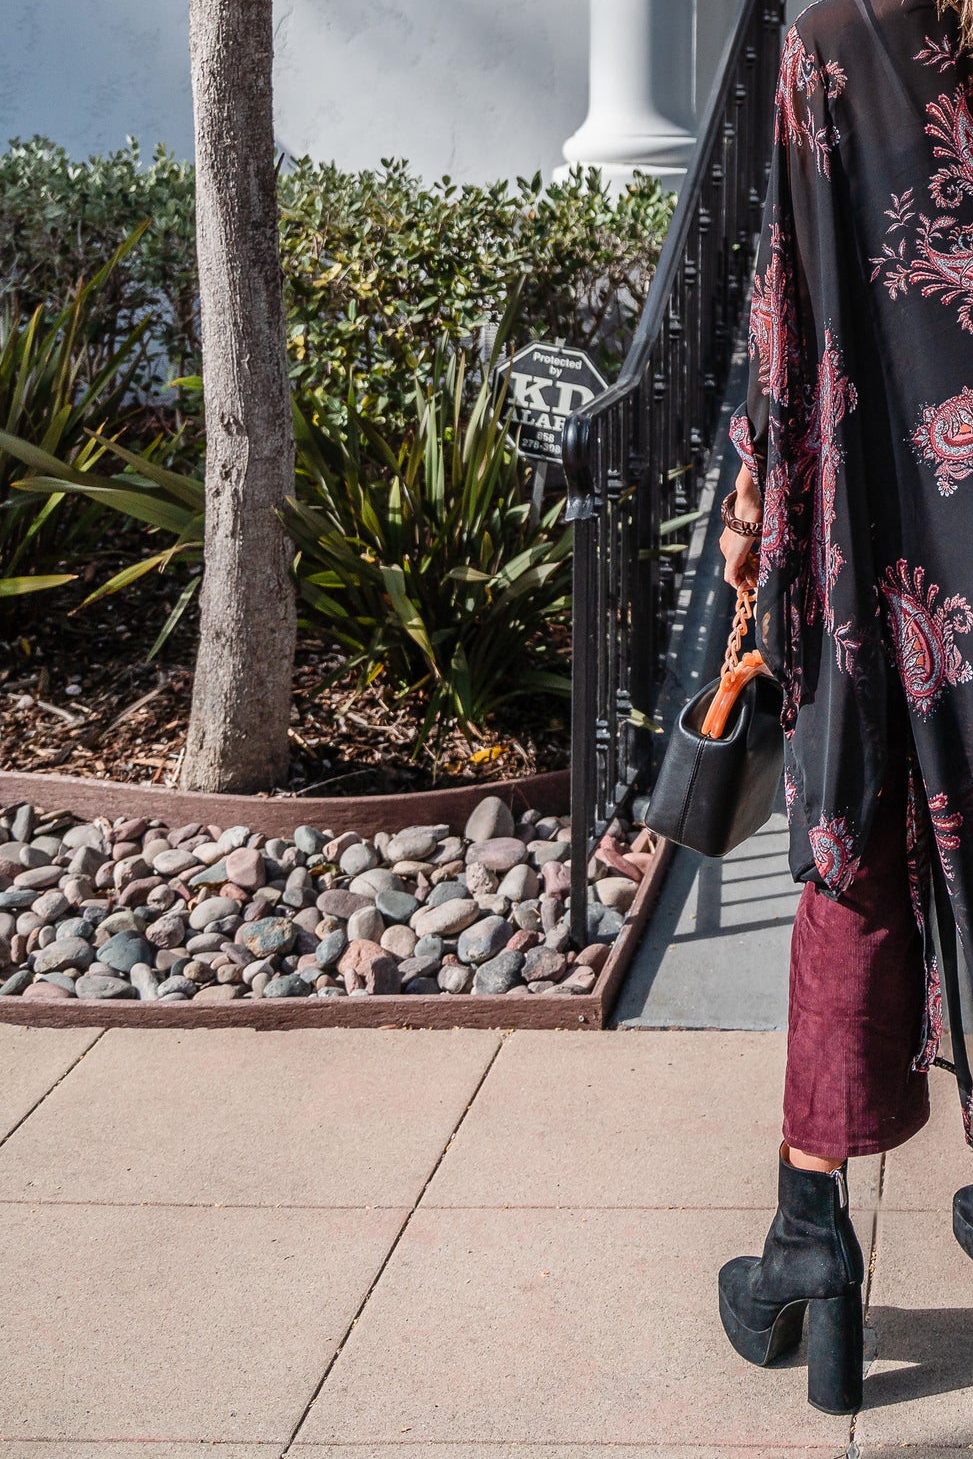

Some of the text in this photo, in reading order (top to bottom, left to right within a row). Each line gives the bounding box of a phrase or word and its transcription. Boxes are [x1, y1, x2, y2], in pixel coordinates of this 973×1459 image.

[532, 351, 583, 370] Protected
[549, 366, 563, 378] by
[508, 372, 595, 416] KD
[503, 407, 566, 432] ALAR
